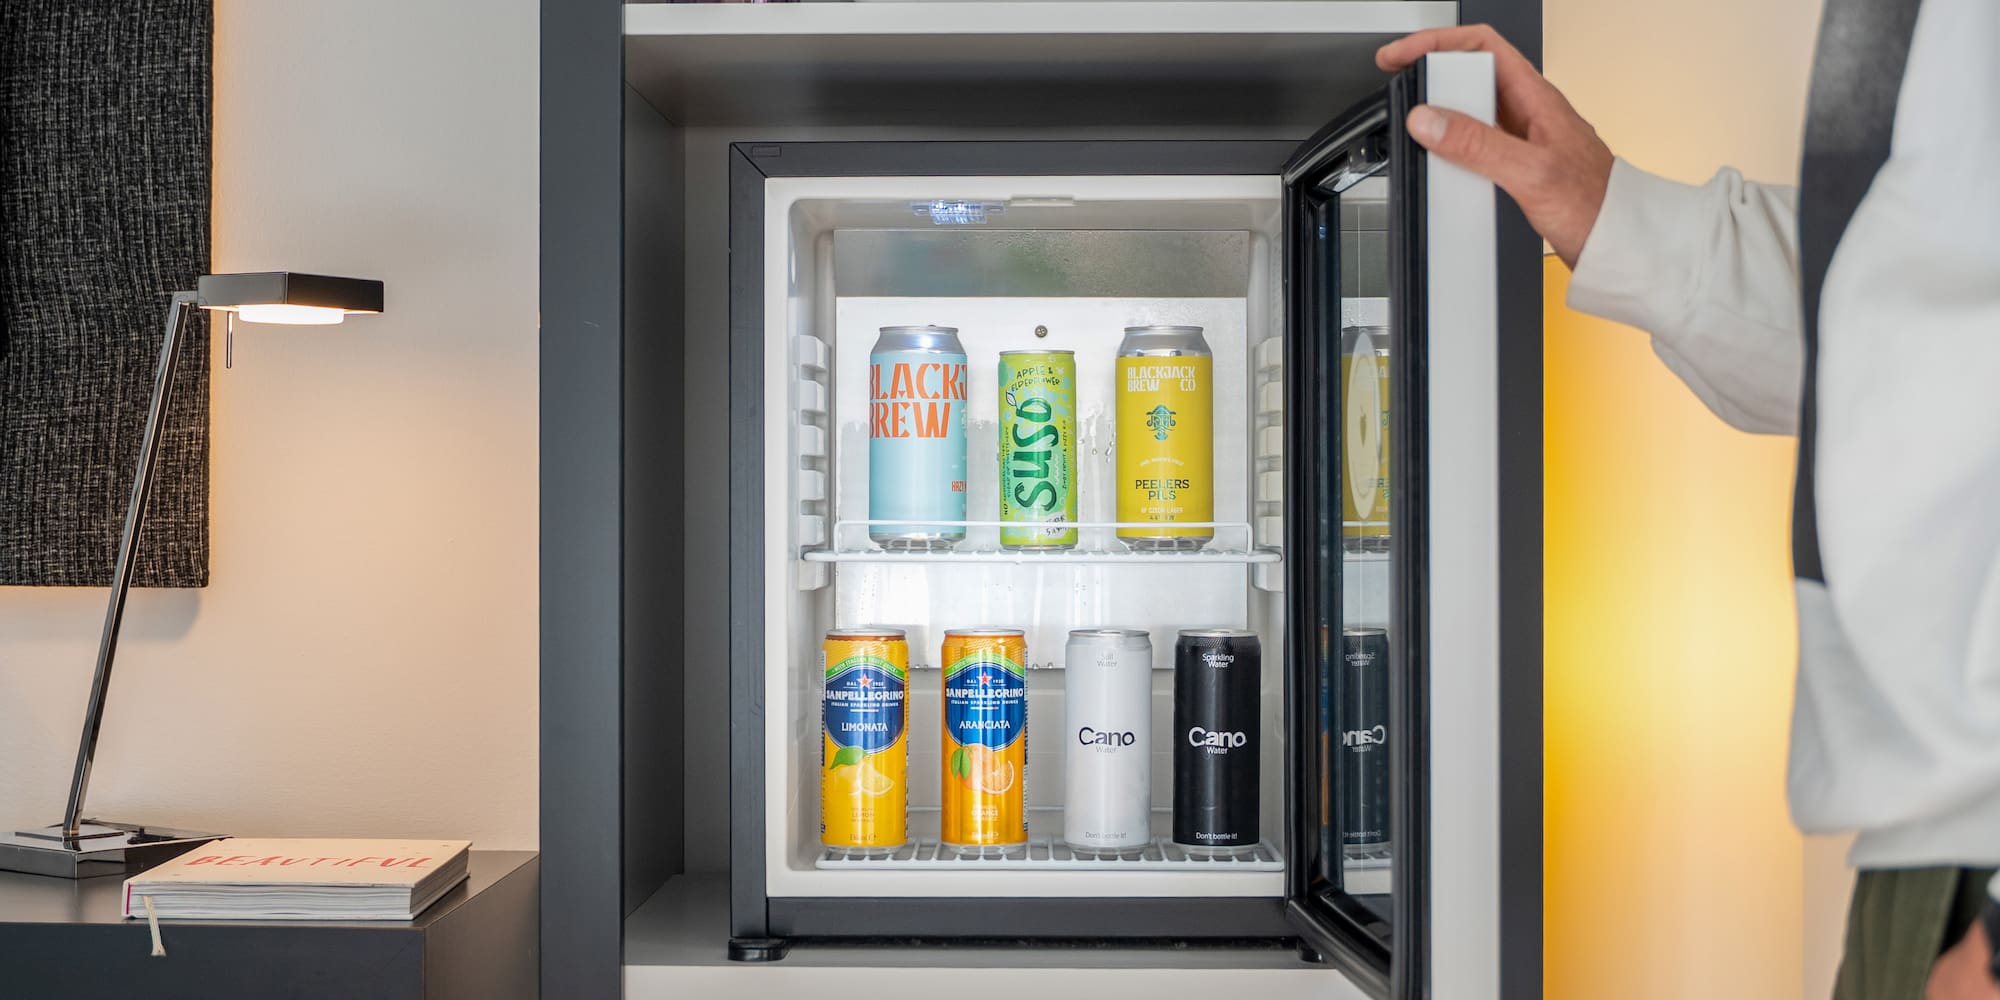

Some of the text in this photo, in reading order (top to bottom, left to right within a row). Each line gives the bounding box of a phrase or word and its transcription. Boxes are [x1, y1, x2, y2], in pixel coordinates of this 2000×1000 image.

[1017, 366, 1045, 379] APPLE
[1127, 366, 1196, 379] BLACKJACK
[1127, 378, 1196, 392] BREW CO
[1135, 479, 1190, 489] PEELERS
[1148, 490, 1176, 500] PILS
[1202, 653, 1234, 663] Sparkling
[1207, 660, 1229, 668] Water
[841, 722, 888, 731] LIMONATA
[959, 720, 1011, 729] ARANCIATA
[1079, 727, 1135, 746] Cano
[1188, 726, 1246, 747] Cano
[1206, 746, 1228, 754] Water
[185, 855, 432, 868] BEAUTIFUL
